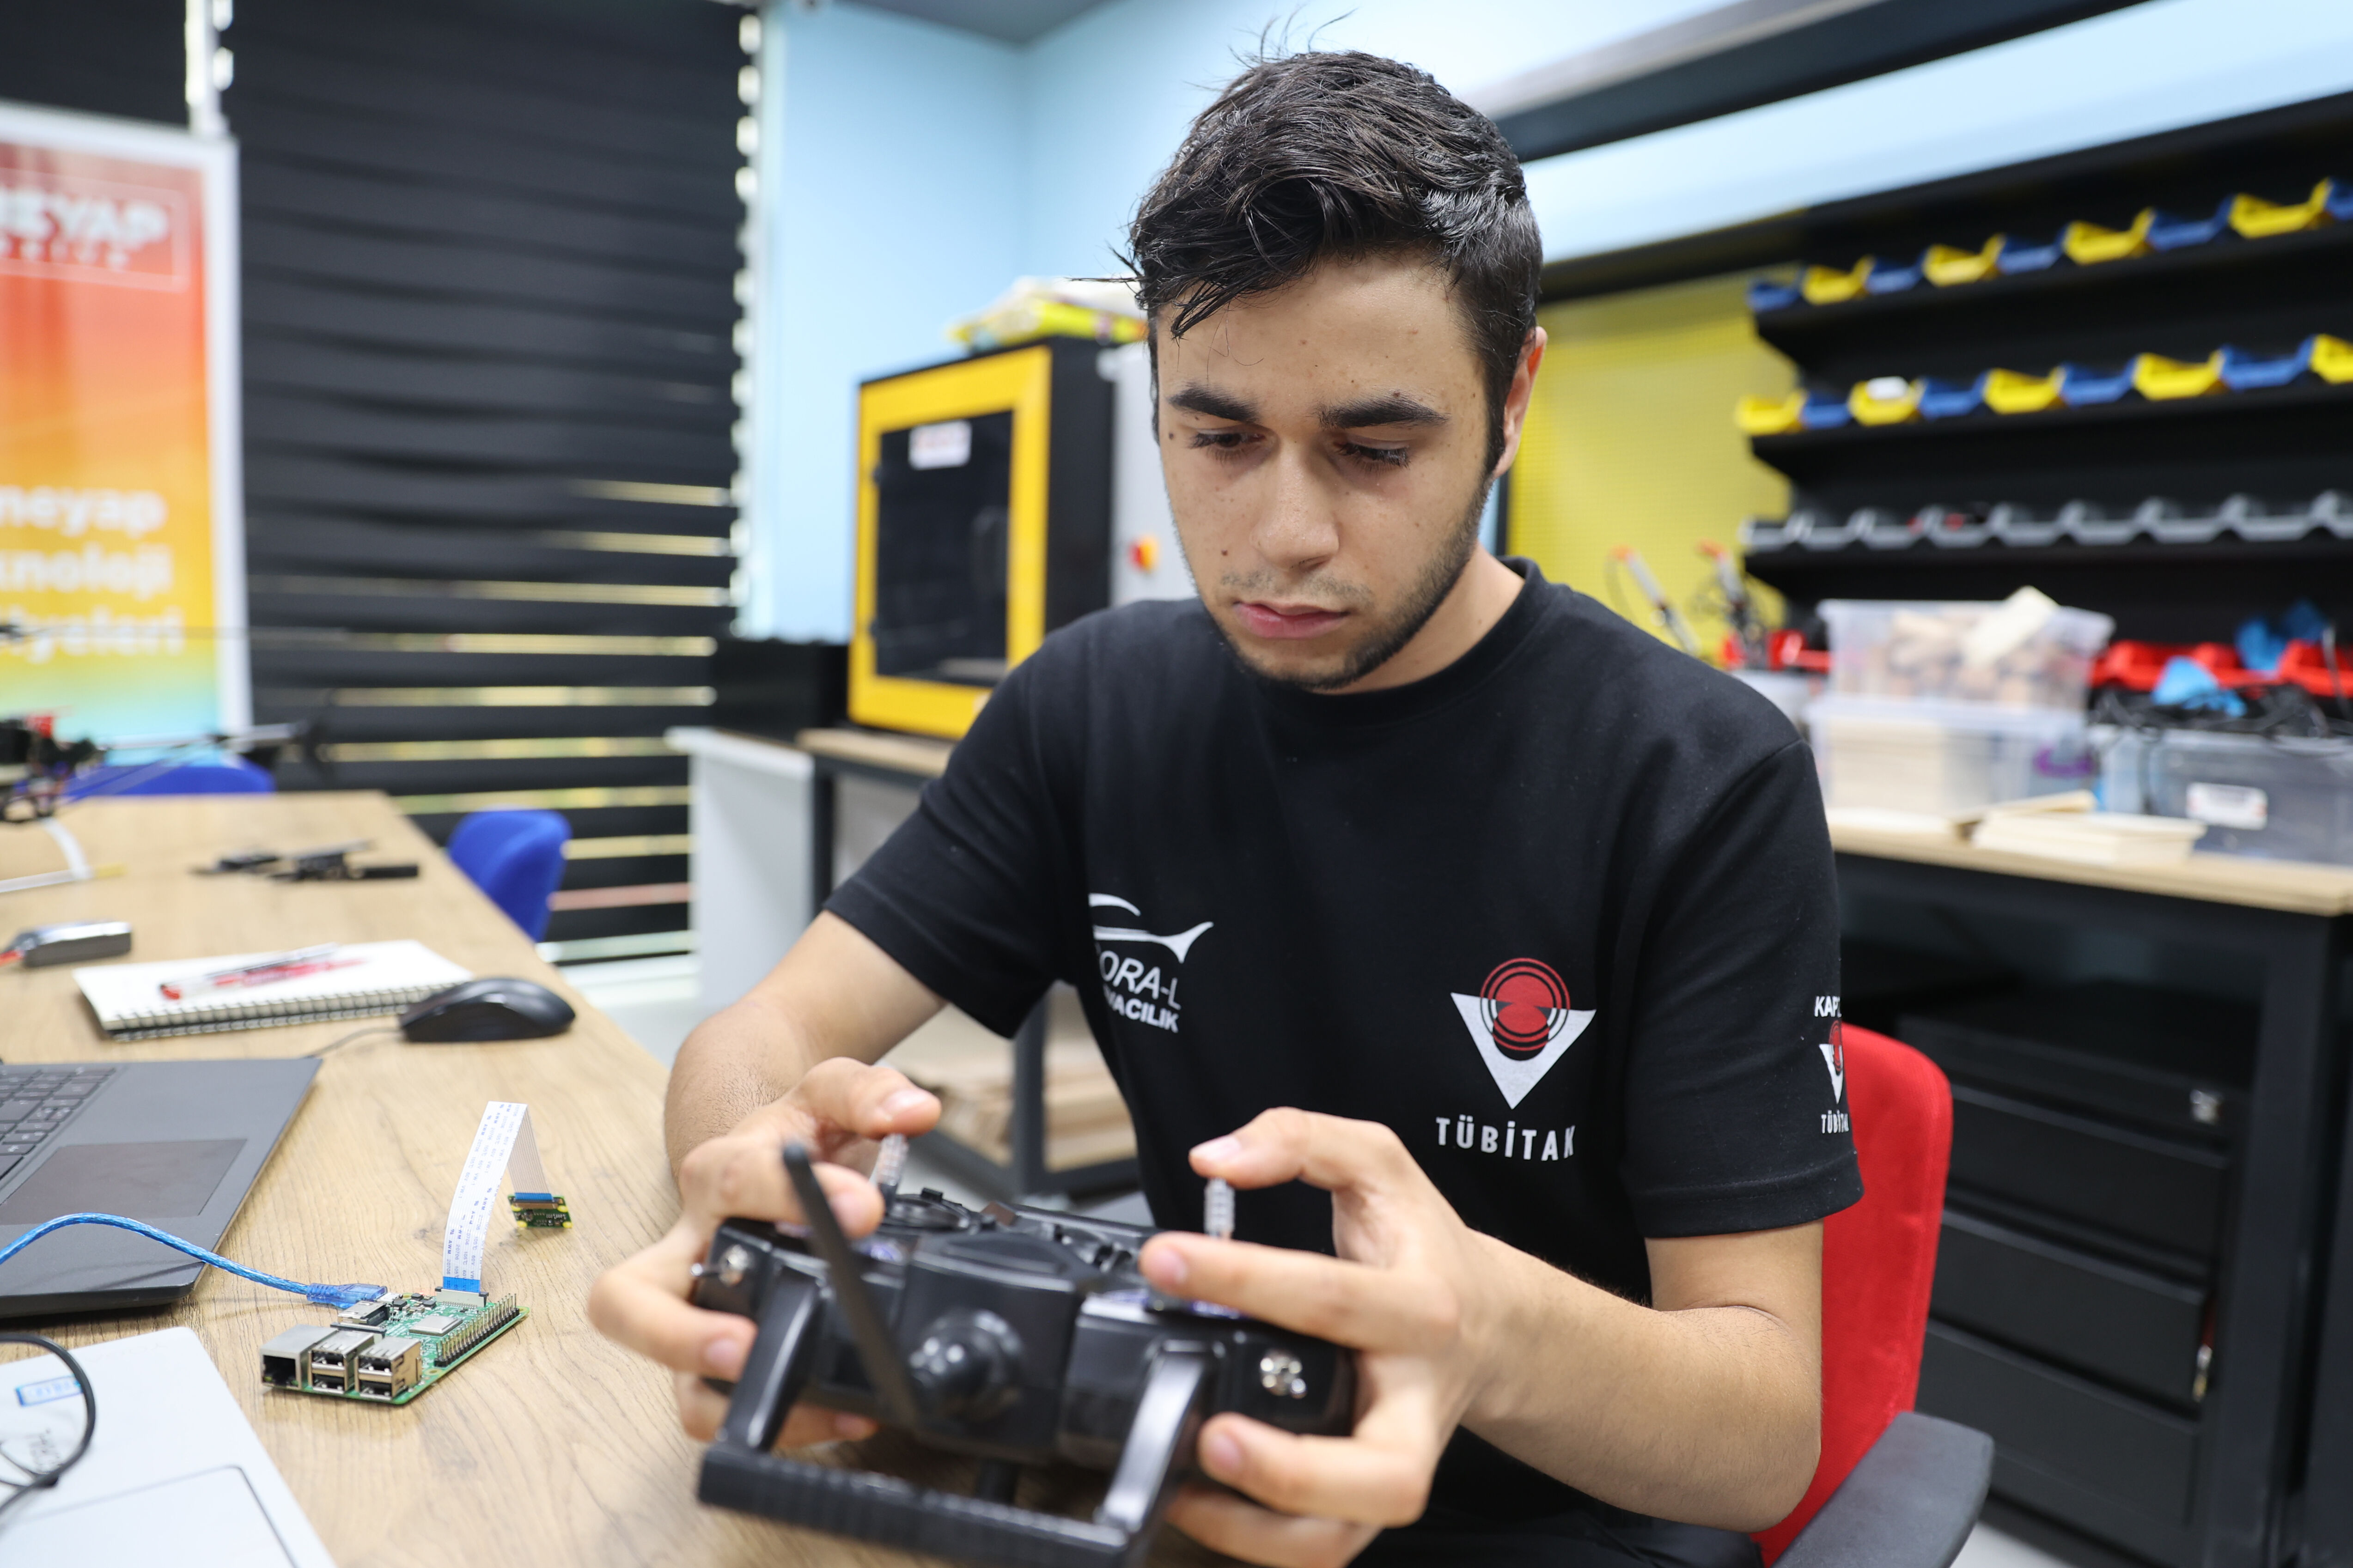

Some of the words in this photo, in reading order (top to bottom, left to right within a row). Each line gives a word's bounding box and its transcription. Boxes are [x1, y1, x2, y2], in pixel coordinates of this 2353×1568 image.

[0, 187, 167, 249] EYAP
[1096, 942, 1181, 1010] ORA-L
[1814, 996, 1842, 1017] KAP
